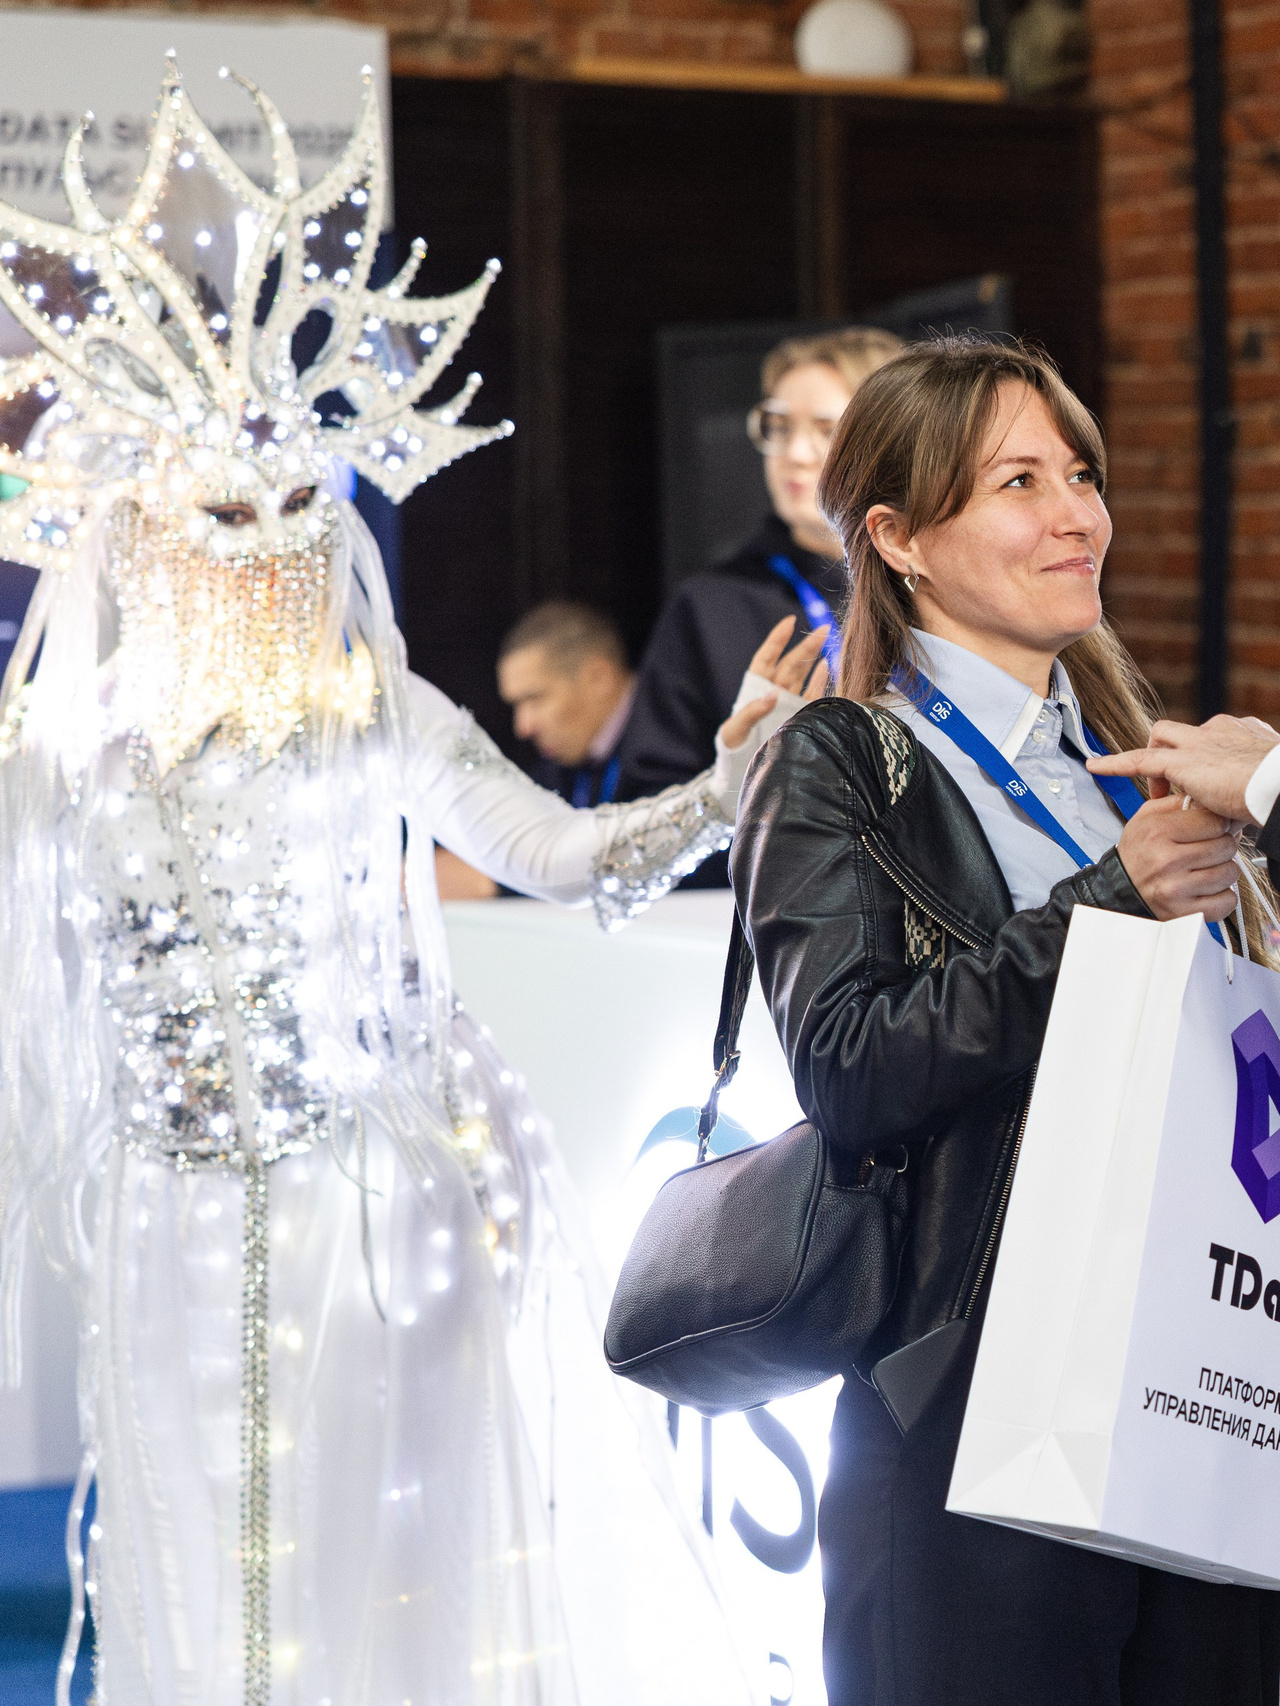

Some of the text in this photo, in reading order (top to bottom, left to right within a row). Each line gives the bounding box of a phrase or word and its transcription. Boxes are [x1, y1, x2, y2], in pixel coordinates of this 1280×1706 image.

[932, 701, 951, 720] DIS
[1008, 780, 1026, 797] DIS
[1143, 1387, 1252, 1441] УПРАВЛЕНИЯ
